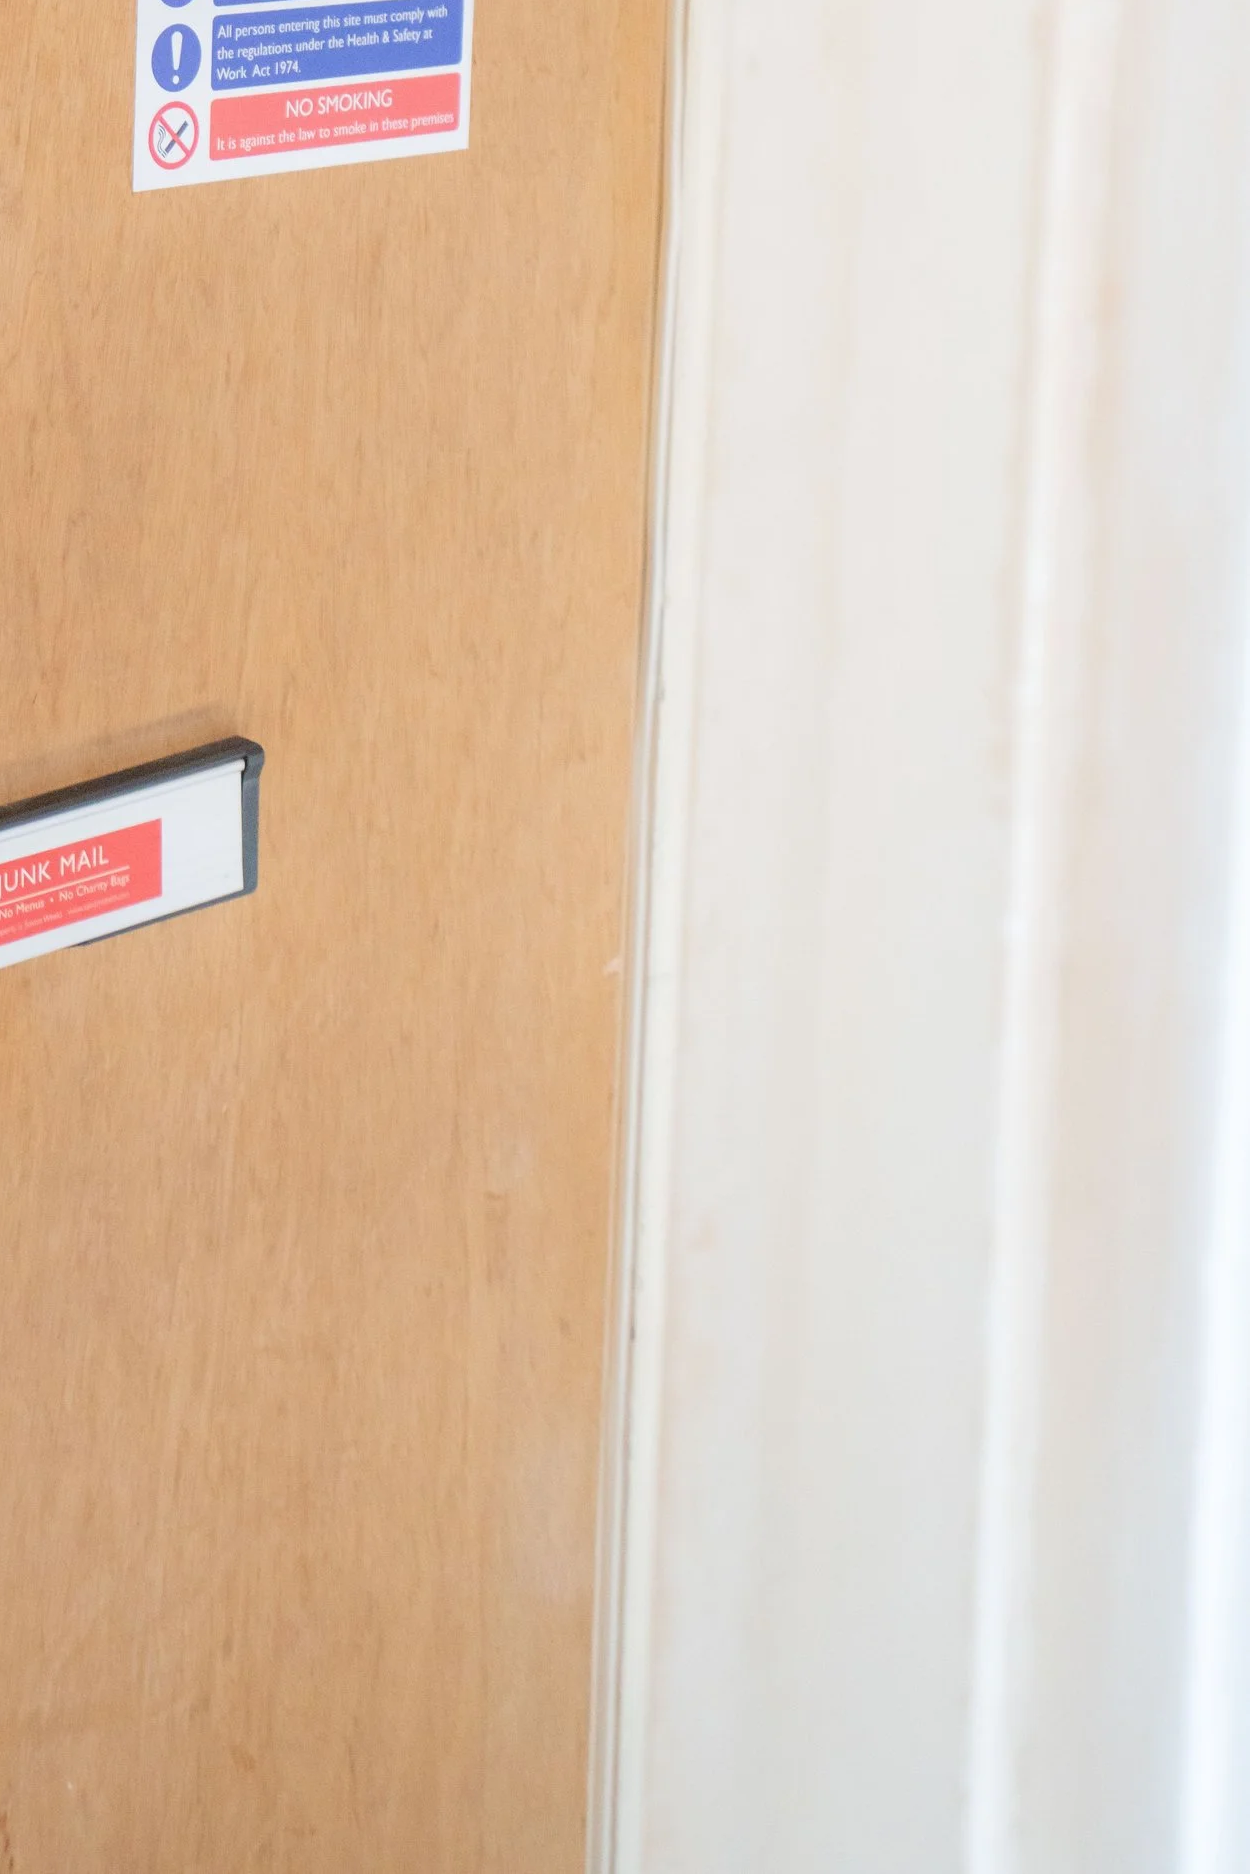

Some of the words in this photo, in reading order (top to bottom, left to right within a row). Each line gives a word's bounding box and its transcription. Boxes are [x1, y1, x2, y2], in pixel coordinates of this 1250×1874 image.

[217, 25, 232, 38] All
[235, 26, 276, 41] persons
[279, 18, 320, 33] entering
[323, 15, 340, 29] this
[344, 14, 361, 26] site
[364, 13, 387, 24] must
[391, 7, 424, 24] comply
[427, 4, 447, 18] with
[217, 46, 234, 60] the
[238, 43, 292, 61] regulations
[296, 38, 325, 52] under
[329, 36, 344, 49] the
[347, 32, 379, 46] Health
[382, 31, 389, 43] &
[393, 28, 421, 43] Safety
[424, 29, 433, 39] at
[217, 66, 247, 80] Work
[252, 64, 270, 77] Act
[275, 60, 301, 75] 1974.
[286, 98, 313, 118] NO
[318, 89, 393, 114] SMOKING
[217, 137, 225, 151] It
[229, 137, 236, 150] is
[240, 133, 275, 151] against
[279, 130, 295, 144] the
[298, 127, 316, 141] law
[319, 127, 330, 139] to
[333, 120, 367, 137] smoke
[370, 120, 378, 132] in
[382, 117, 408, 131] these
[412, 112, 454, 131] premises
[60, 845, 109, 877] MAIL
[0, 908, 13, 920] No
[16, 900, 44, 915] Menus
[59, 891, 73, 902] No
[76, 881, 108, 896] Charity
[111, 875, 130, 887] Bags
